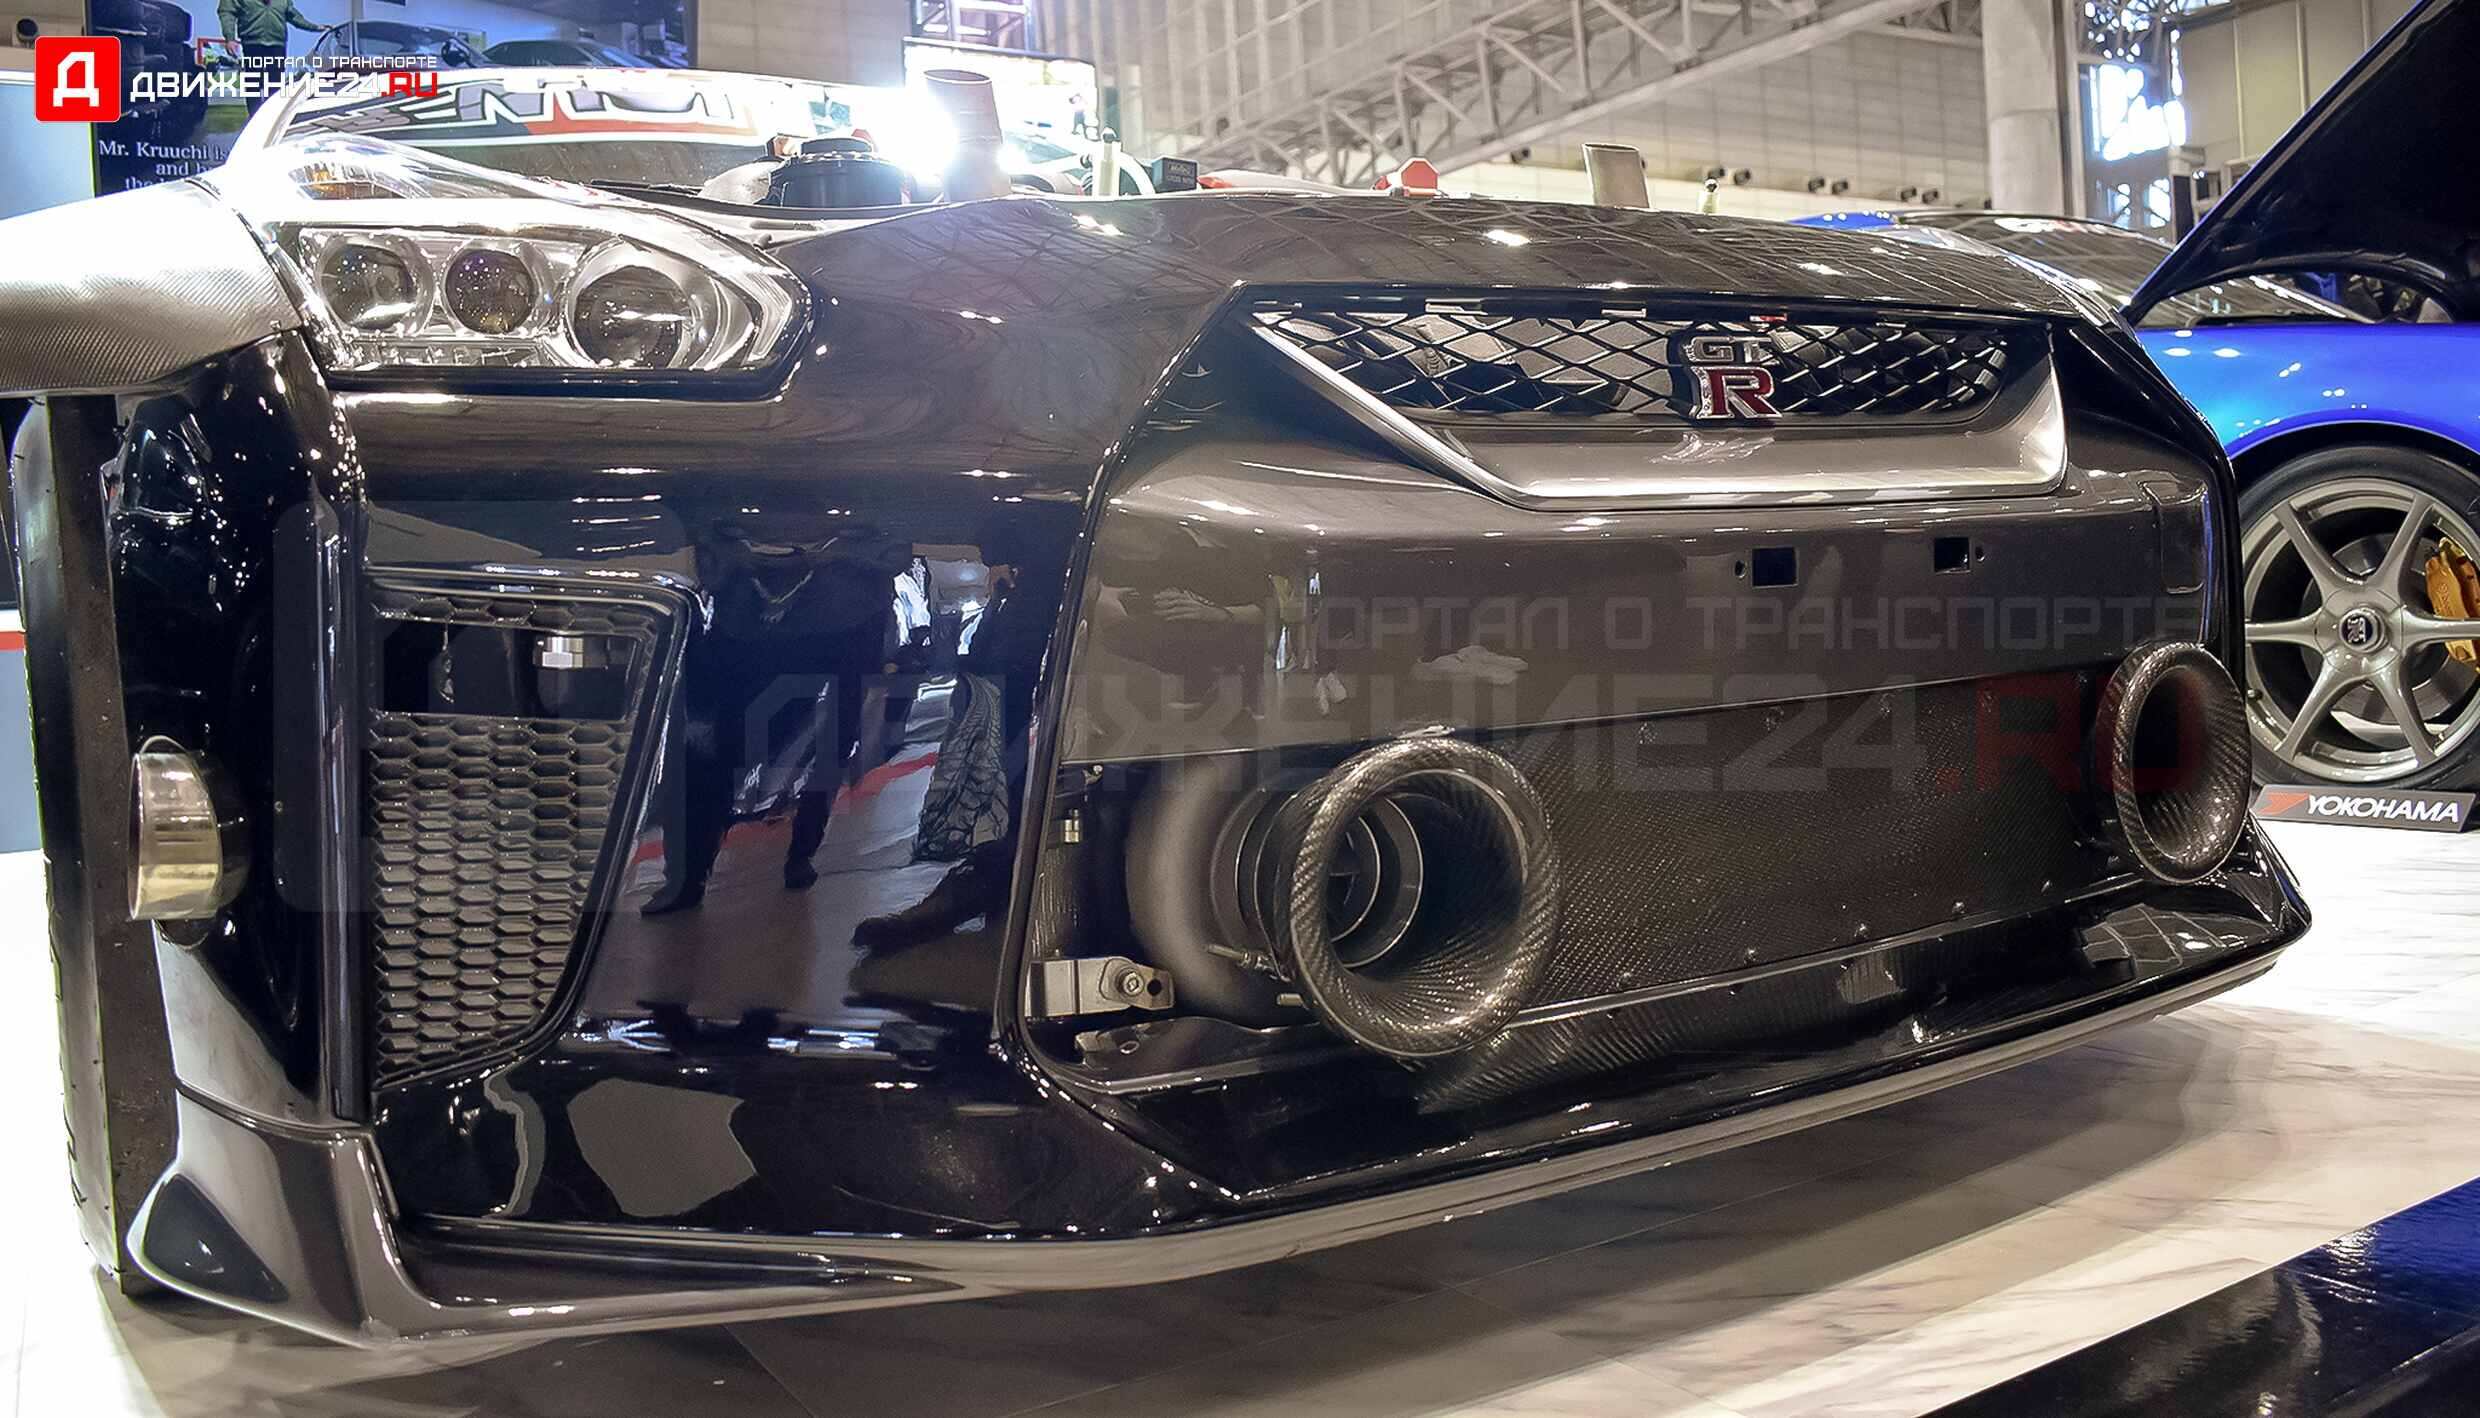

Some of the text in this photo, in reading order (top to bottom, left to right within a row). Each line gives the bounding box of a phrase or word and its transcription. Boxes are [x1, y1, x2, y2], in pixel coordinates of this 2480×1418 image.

[98, 140, 129, 157] Mr.
[155, 161, 189, 176] and
[2307, 794, 2460, 823] YOKOHAMA
